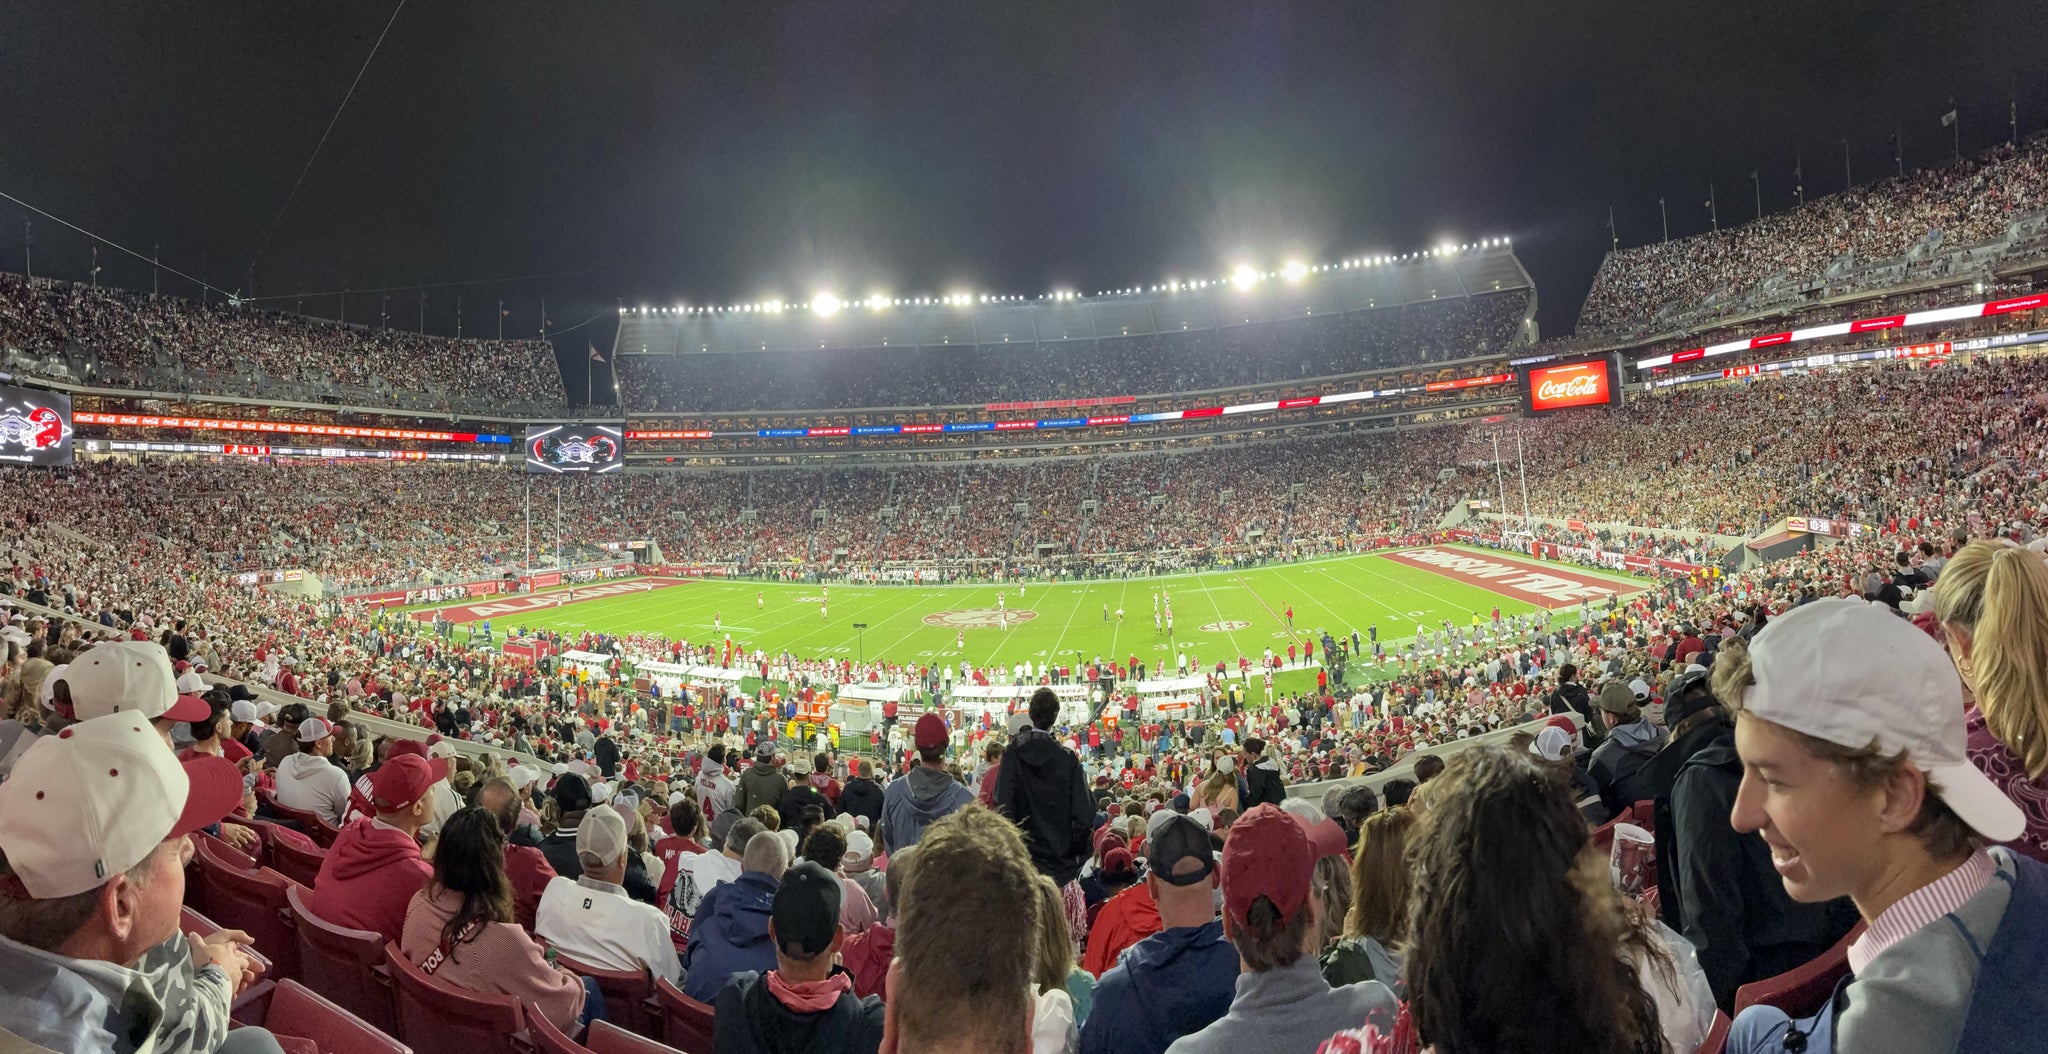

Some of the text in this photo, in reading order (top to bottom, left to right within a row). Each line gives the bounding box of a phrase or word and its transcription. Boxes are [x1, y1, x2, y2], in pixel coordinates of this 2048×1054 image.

[1934, 344, 1945, 355] 17
[1811, 356, 1831, 365] 10:38
[1538, 374, 1600, 400] Coca-Cola
[86, 441, 98, 451] 25
[258, 446, 266, 455] 14
[1810, 520, 1829, 533] 10:38
[1850, 524, 1861, 537] 25
[1396, 549, 1619, 603] CRIMSON TIDE
[466, 580, 669, 617] ALABAMA
[818, 705, 826, 714] G
[1108, 719, 1115, 727] G
[700, 778, 716, 790] YELDON
[1124, 773, 1134, 783] 27
[702, 796, 716, 822] 4
[582, 897, 592, 910] FJ
